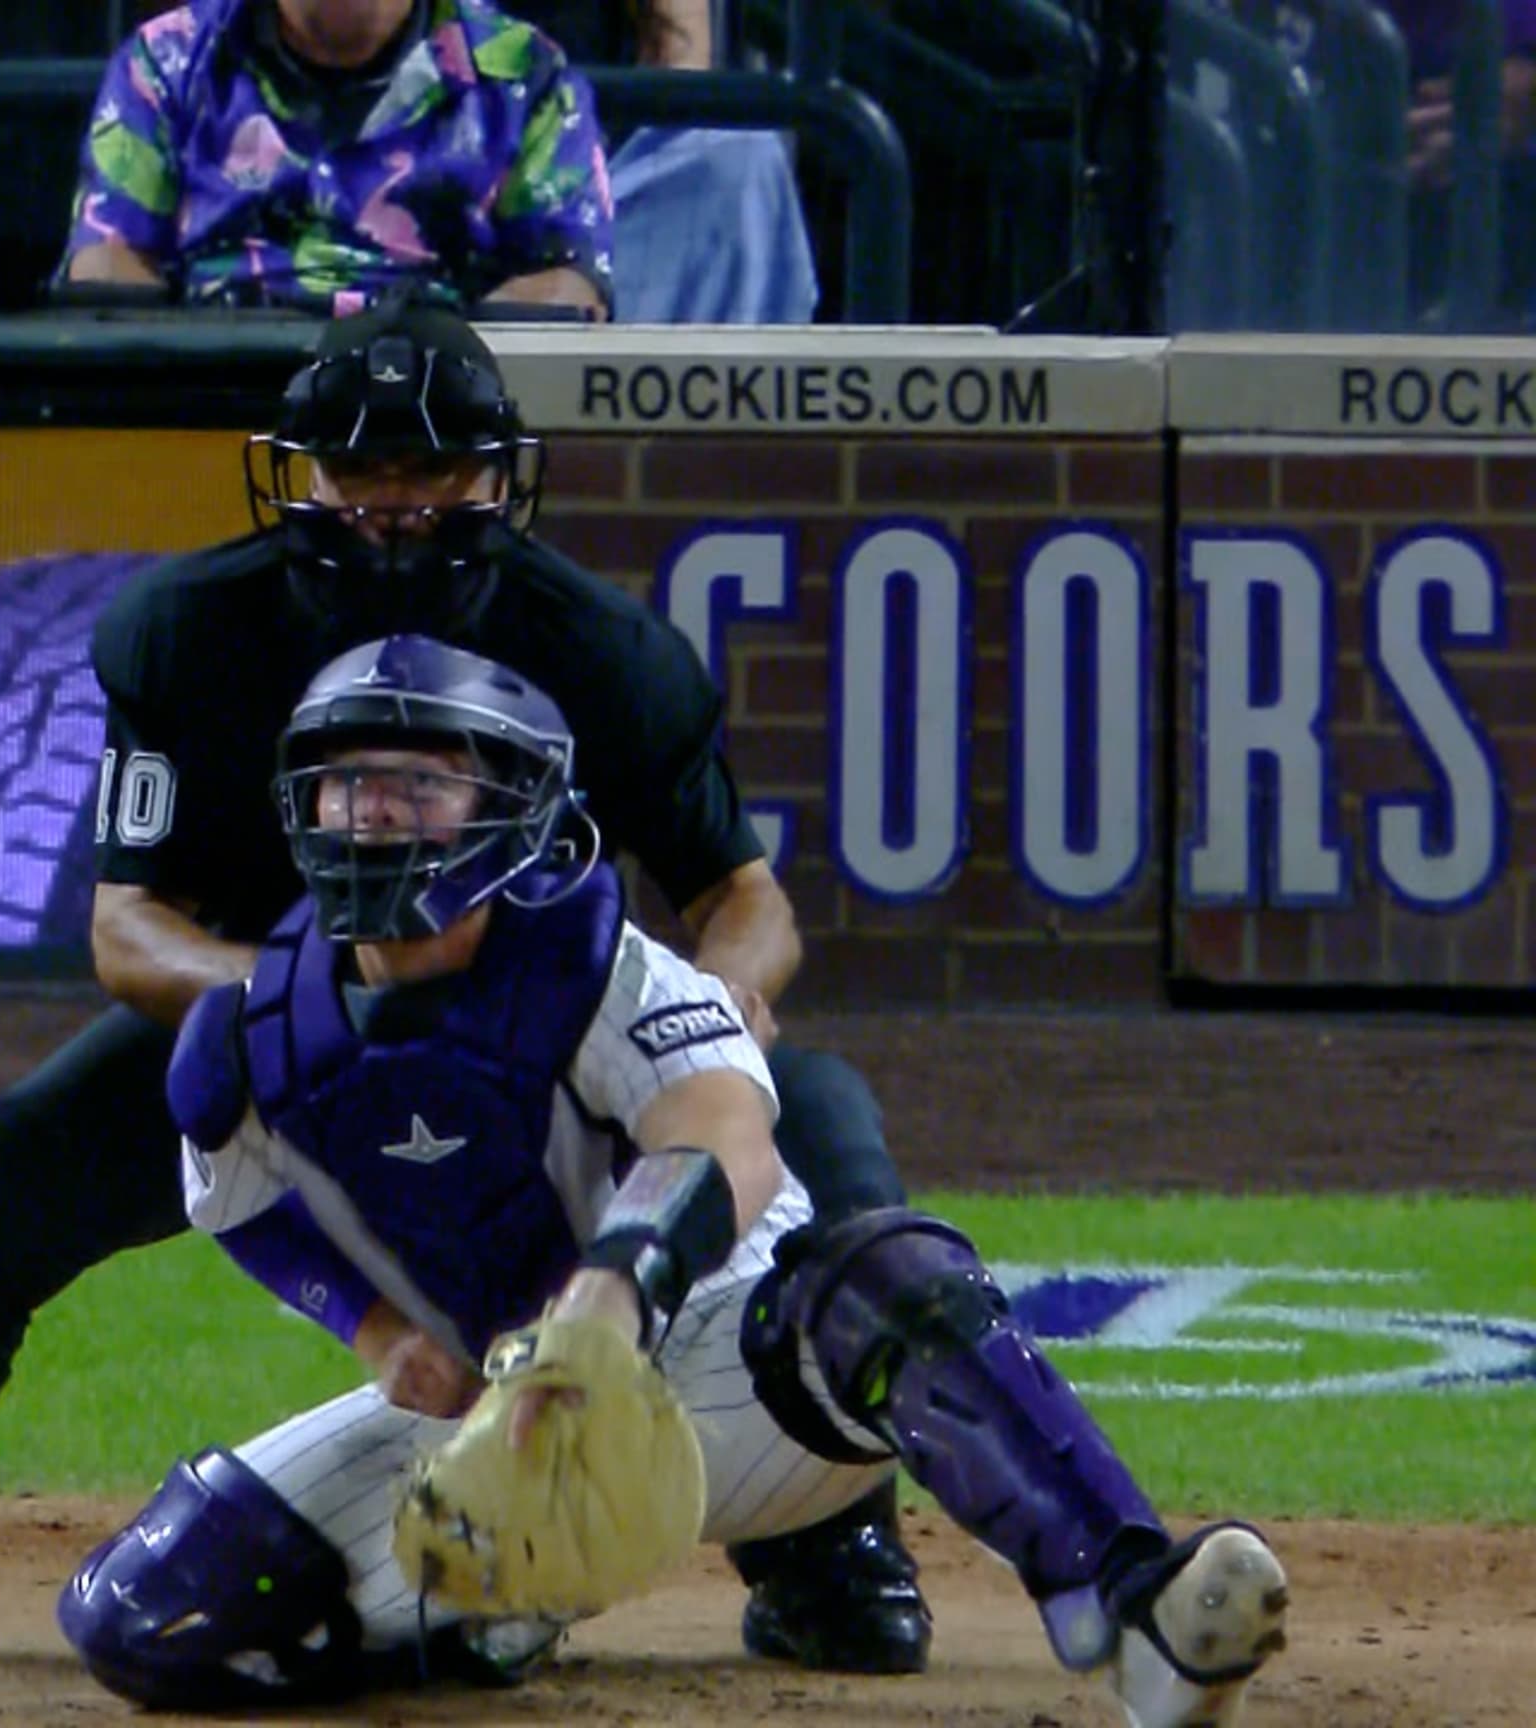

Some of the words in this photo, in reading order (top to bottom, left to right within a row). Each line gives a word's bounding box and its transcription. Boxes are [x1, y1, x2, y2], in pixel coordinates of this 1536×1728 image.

[579, 365, 1050, 424] ROCKIES.COM
[1339, 366, 1536, 427] ROCK
[95, 748, 177, 847] 10
[632, 1005, 732, 1051] YORK
